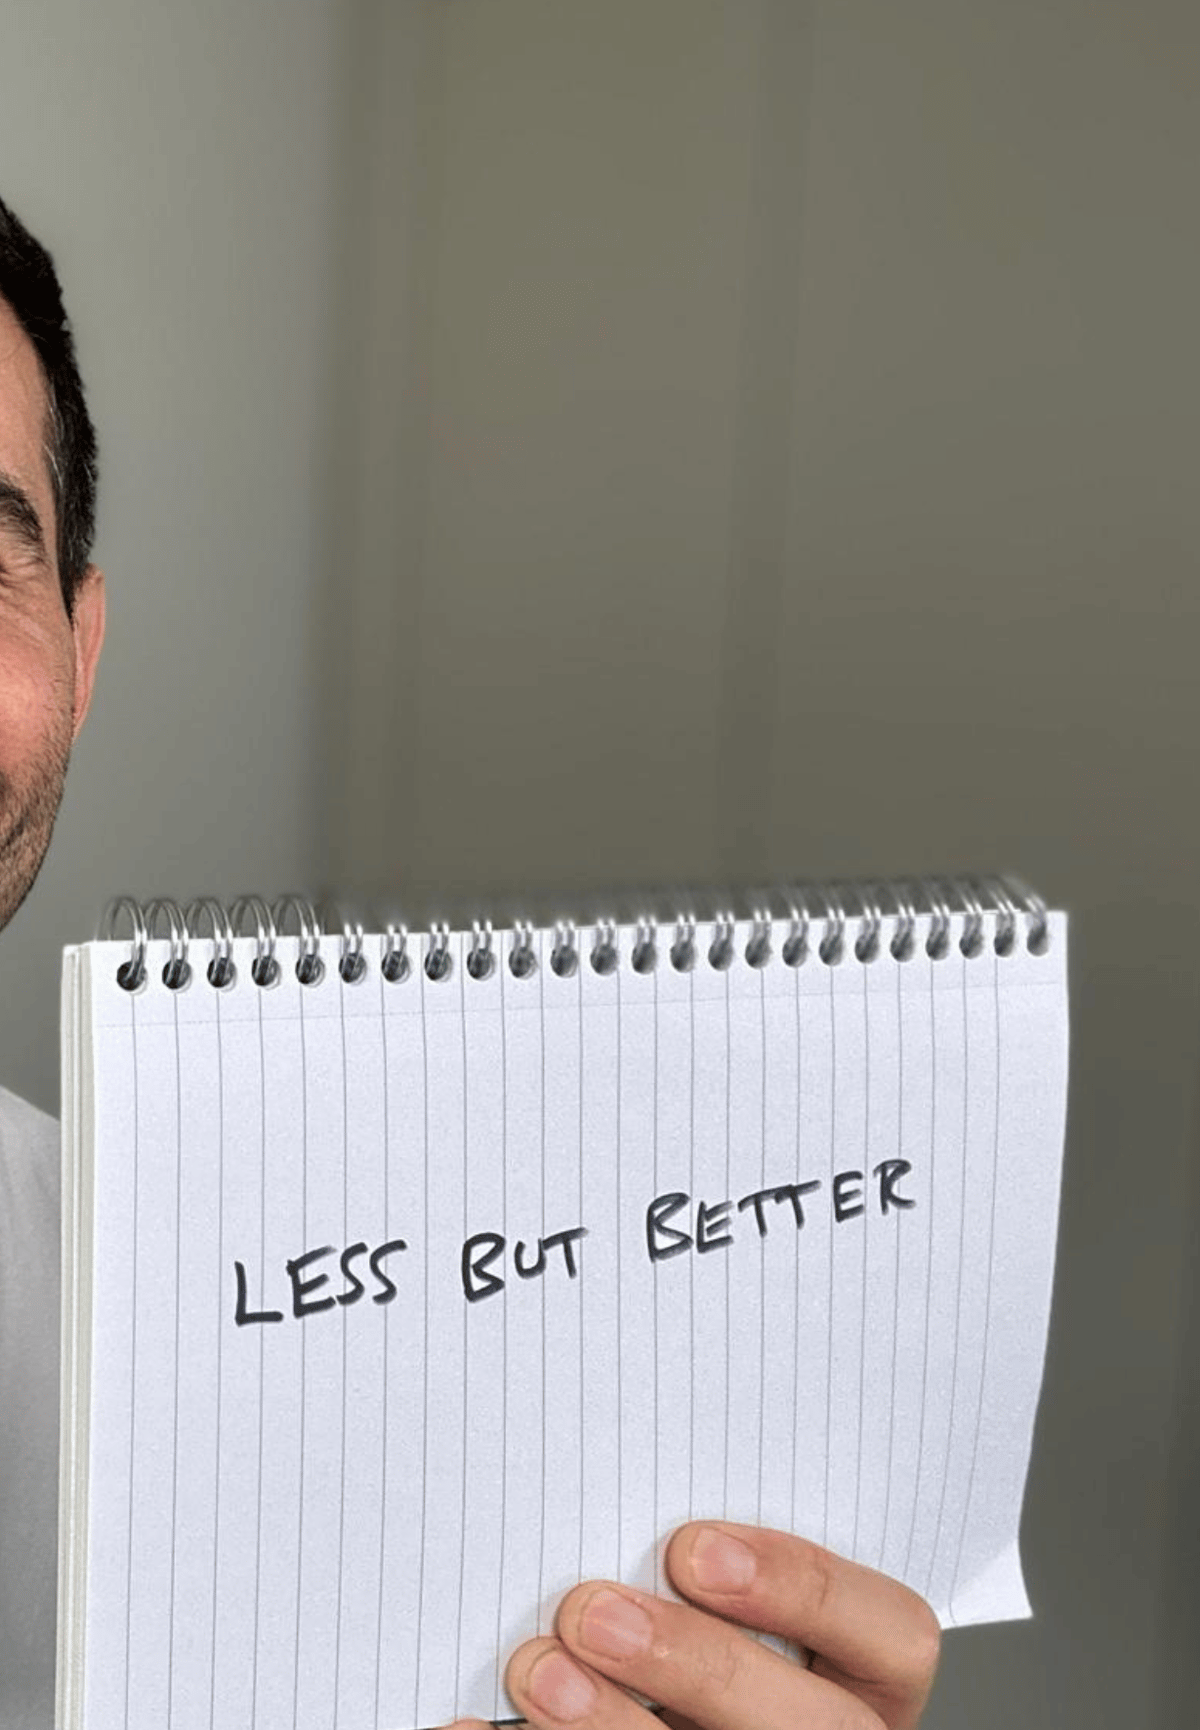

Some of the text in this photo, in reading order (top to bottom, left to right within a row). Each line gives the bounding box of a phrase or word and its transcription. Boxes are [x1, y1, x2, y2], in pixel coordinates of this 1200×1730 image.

[234, 1158, 916, 1327] LESS BUT BETTER
